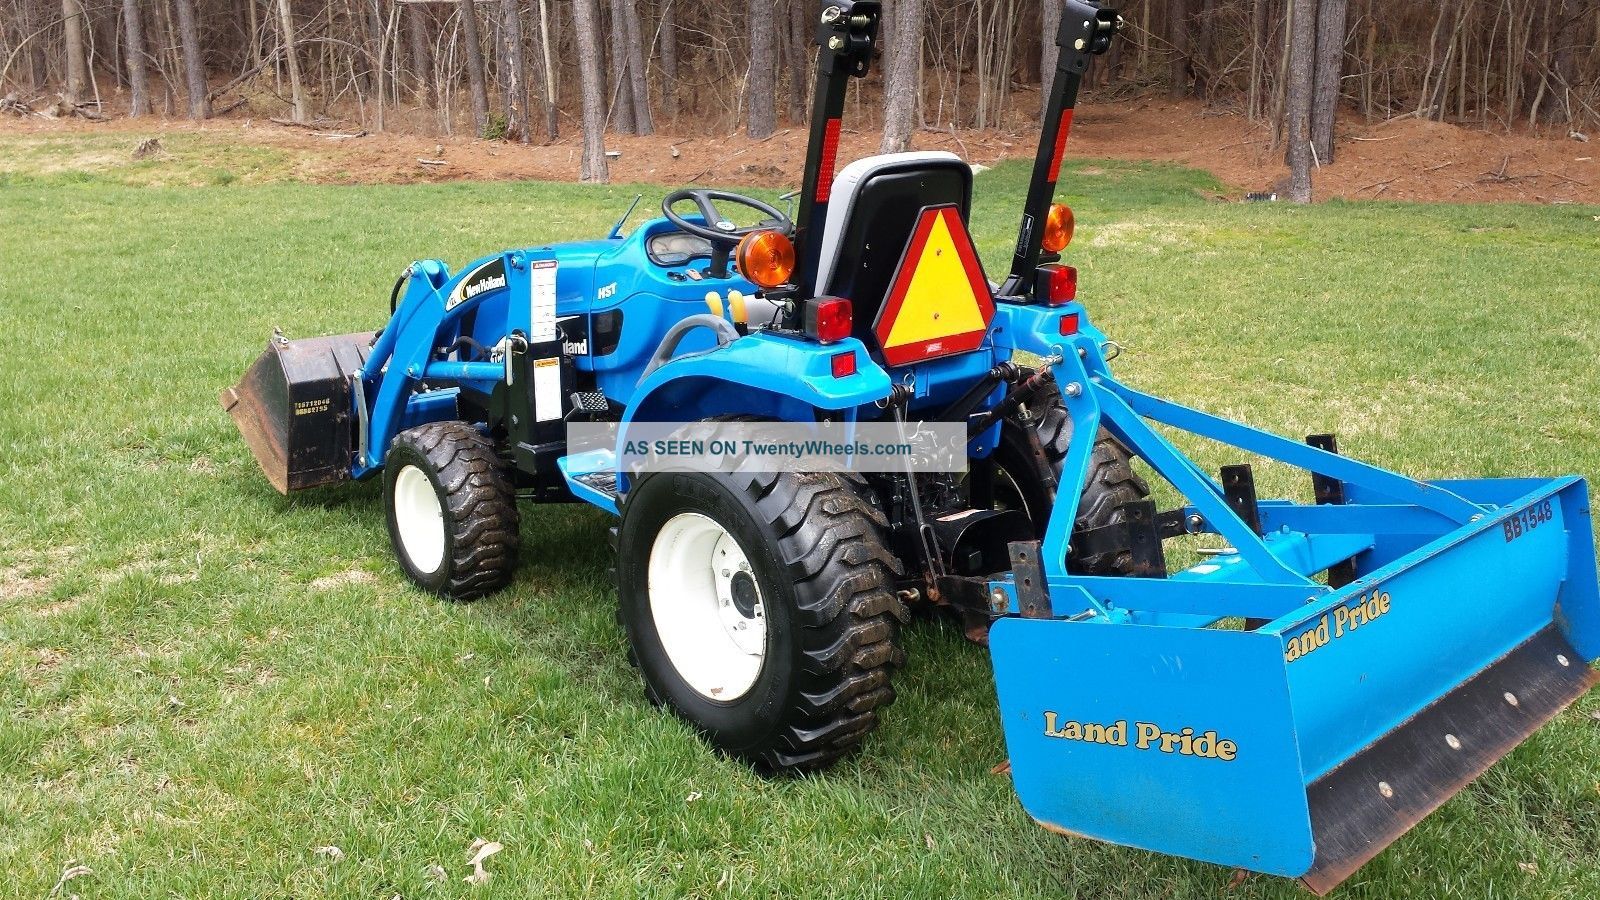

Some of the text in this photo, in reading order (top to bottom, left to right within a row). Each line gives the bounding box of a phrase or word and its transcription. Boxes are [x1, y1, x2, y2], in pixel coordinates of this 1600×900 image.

[466, 274, 506, 298] New Holland
[598, 282, 617, 300] HST
[1503, 500, 1553, 543] BB1548
[1285, 588, 1391, 663] and Pride
[1043, 711, 1238, 761] Land Pride
